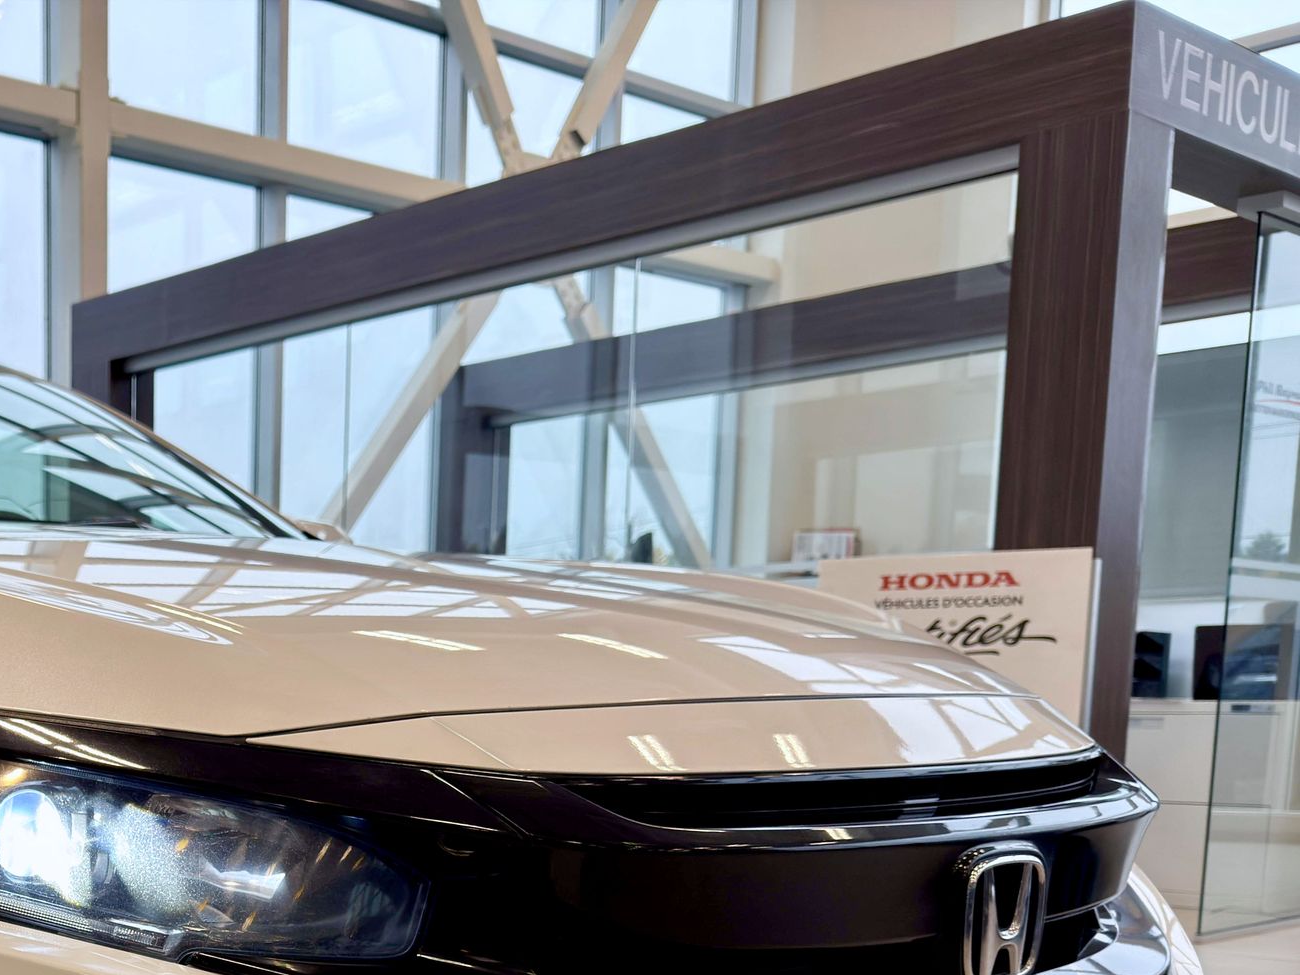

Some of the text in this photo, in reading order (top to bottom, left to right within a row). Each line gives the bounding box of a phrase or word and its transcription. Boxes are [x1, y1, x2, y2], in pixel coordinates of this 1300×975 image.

[1158, 29, 1300, 155] VEHICUL
[879, 570, 1020, 591] HONDA
[874, 595, 1024, 610] VÉHICULES D'OCCASION
